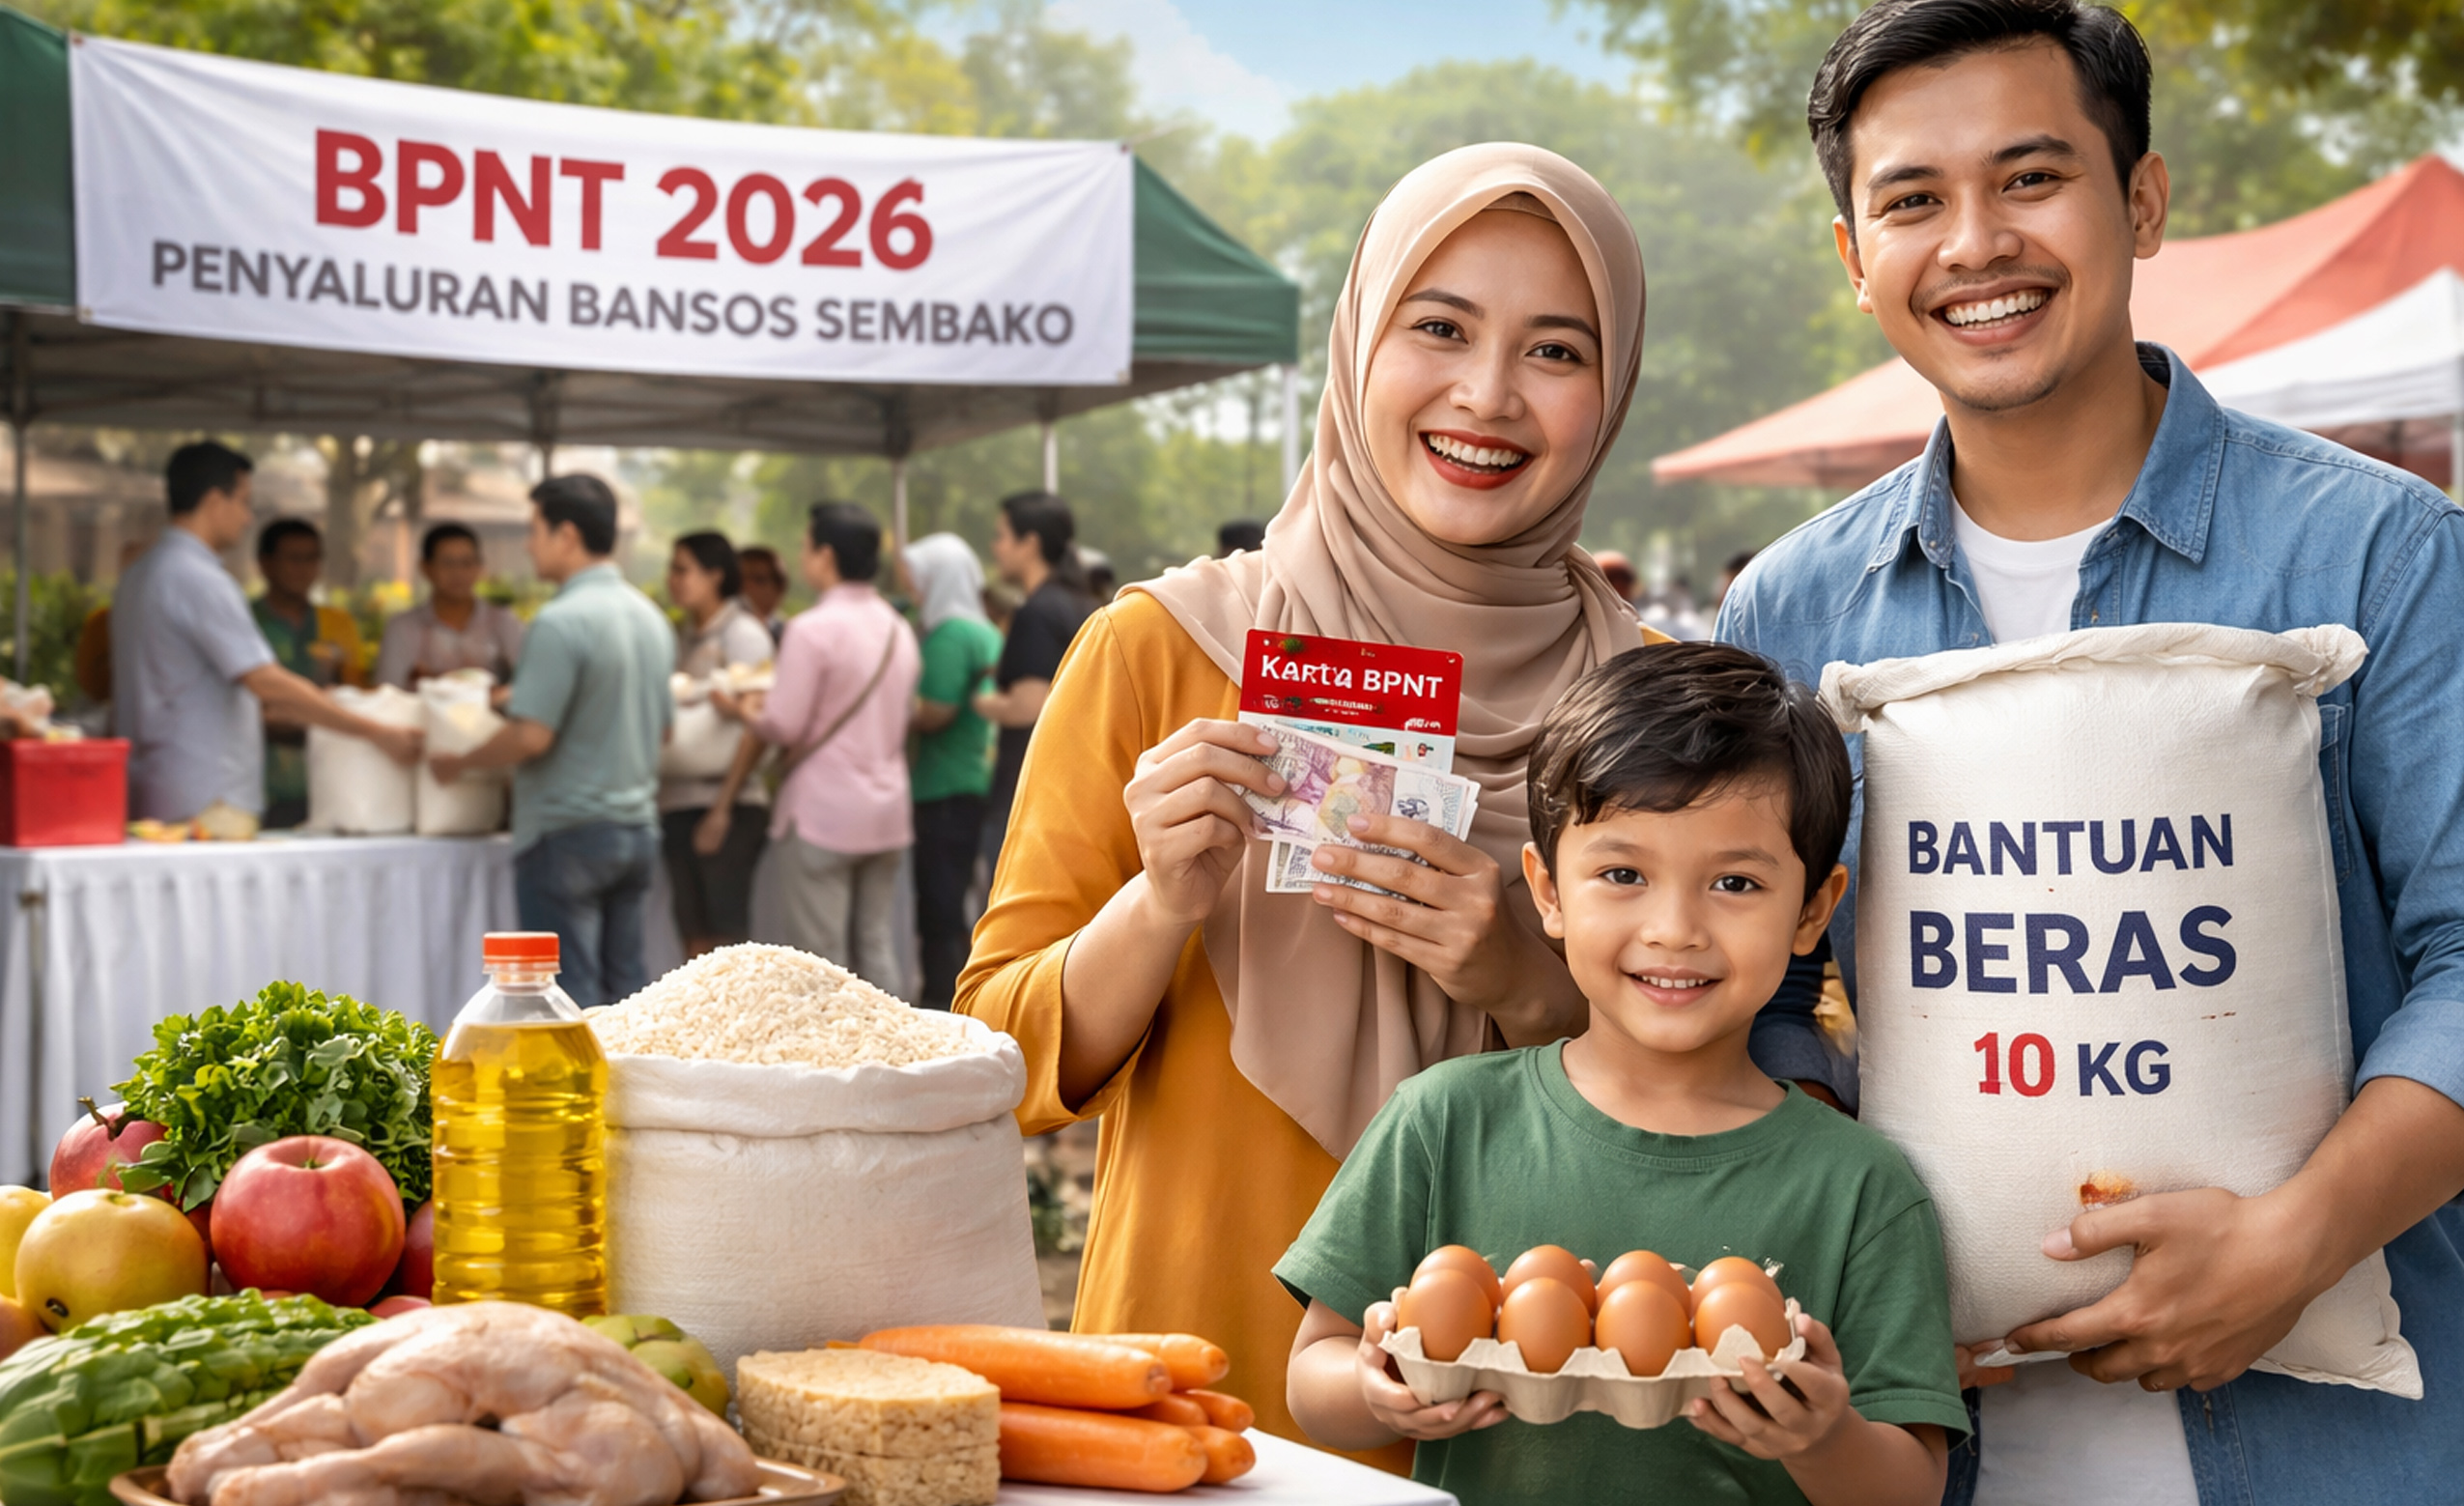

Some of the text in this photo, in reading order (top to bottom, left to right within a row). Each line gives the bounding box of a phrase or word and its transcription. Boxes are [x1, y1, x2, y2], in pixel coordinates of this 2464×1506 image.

[315, 128, 935, 271] BPNT 2026
[151, 239, 1076, 347] PENYALURAN BANSOS SEMBAKO
[1362, 668, 1444, 699] BPNT
[1908, 813, 2234, 876] BANTUAN
[1909, 904, 2238, 995] BERAS
[1973, 1031, 2171, 1097] 10 KG
